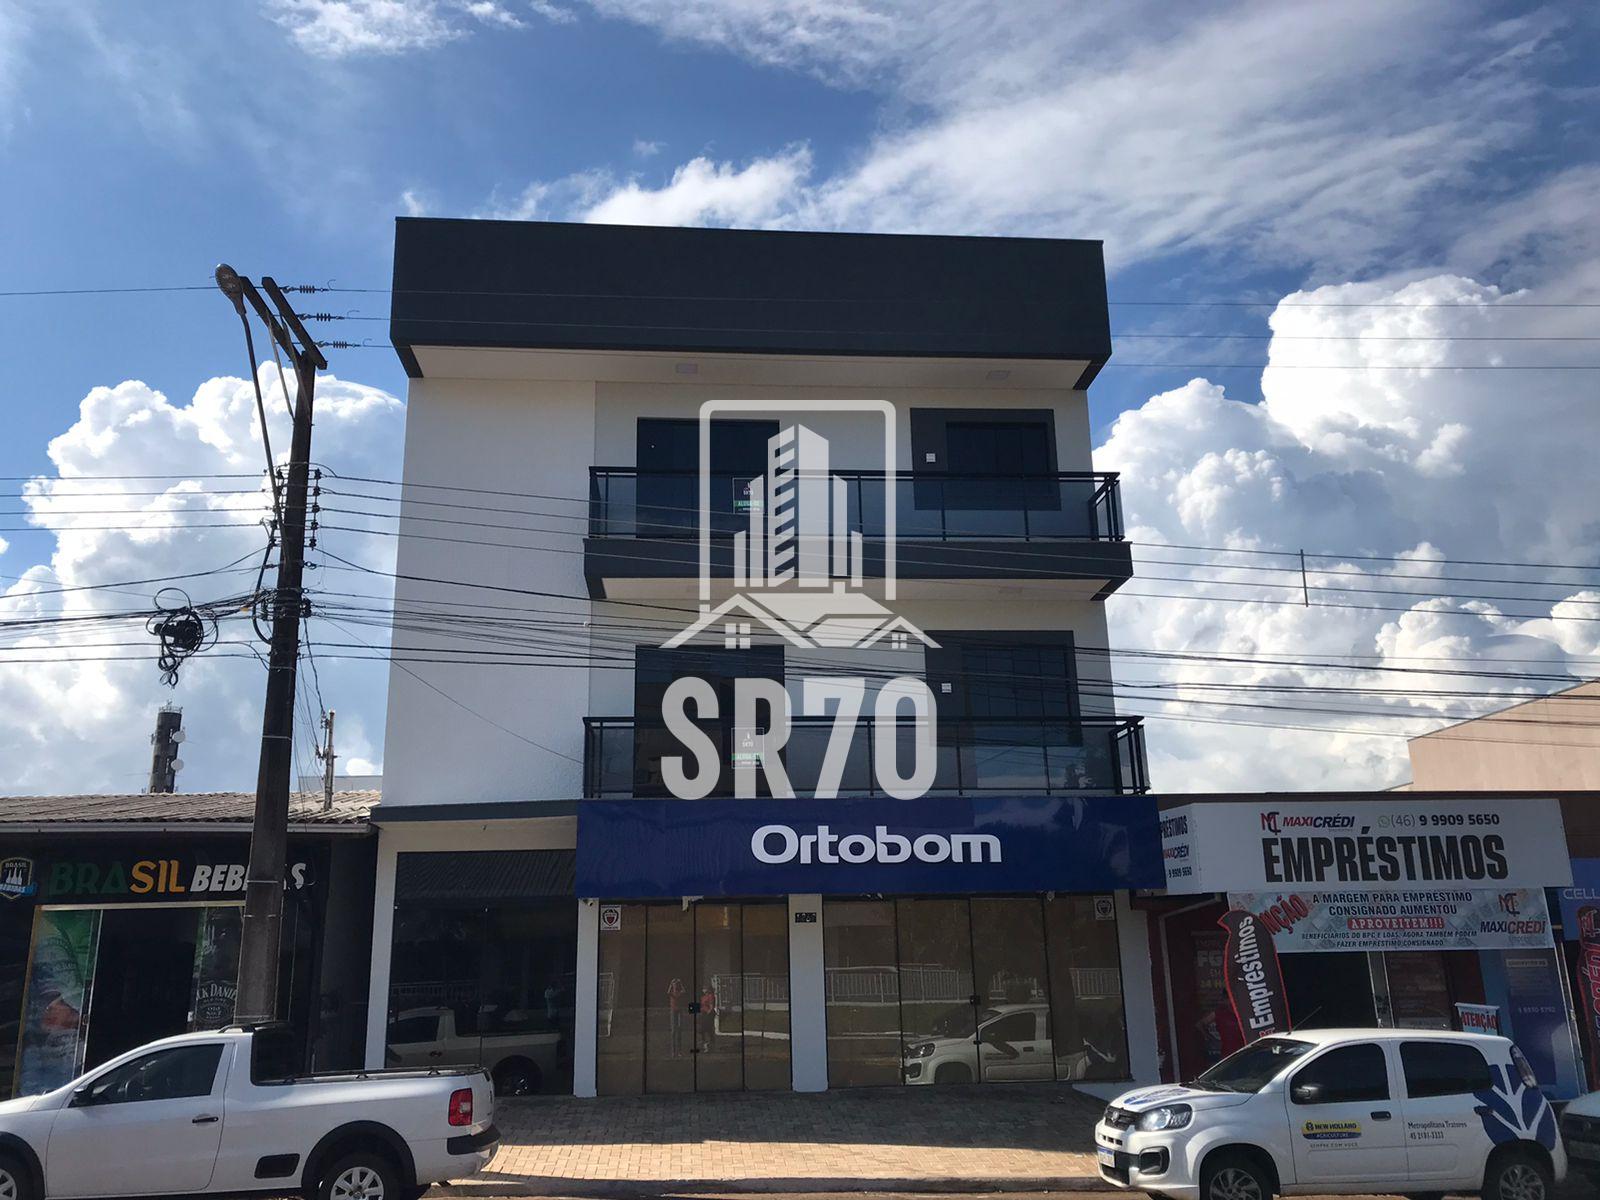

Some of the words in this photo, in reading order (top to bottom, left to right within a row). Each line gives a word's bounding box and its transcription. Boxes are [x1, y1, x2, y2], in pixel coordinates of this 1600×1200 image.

[1283, 813, 1355, 828] MAXICRÉDI
[1391, 814, 1415, 827] (46)
[1419, 815, 1427, 826] 9
[1431, 814, 1464, 826] 9909
[1468, 814, 1500, 825] 5650
[751, 824, 1002, 864] Ortobom
[1262, 826, 1508, 882] EMPRÉSTIMOS
[51, 860, 185, 895] BRASIL
[190, 863, 306, 891] BEBS
[1312, 894, 1320, 904] A
[1323, 893, 1369, 904] MARGEM
[1373, 893, 1400, 904] PARA
[1329, 905, 1397, 916] CONSIGNADO
[1401, 904, 1457, 915] AUMENTOU
[1351, 917, 1443, 929] APROVEITEM!!!
[1480, 917, 1546, 934] MAXICRÉDI
[1337, 940, 1357, 948] FAZER
[1403, 939, 1444, 947] CONSIGNADO
[1234, 916, 1274, 1029] Empréstimos
[1461, 1010, 1498, 1031] ATENÇÃO
[1330, 1122, 1357, 1130] HOLLAND
